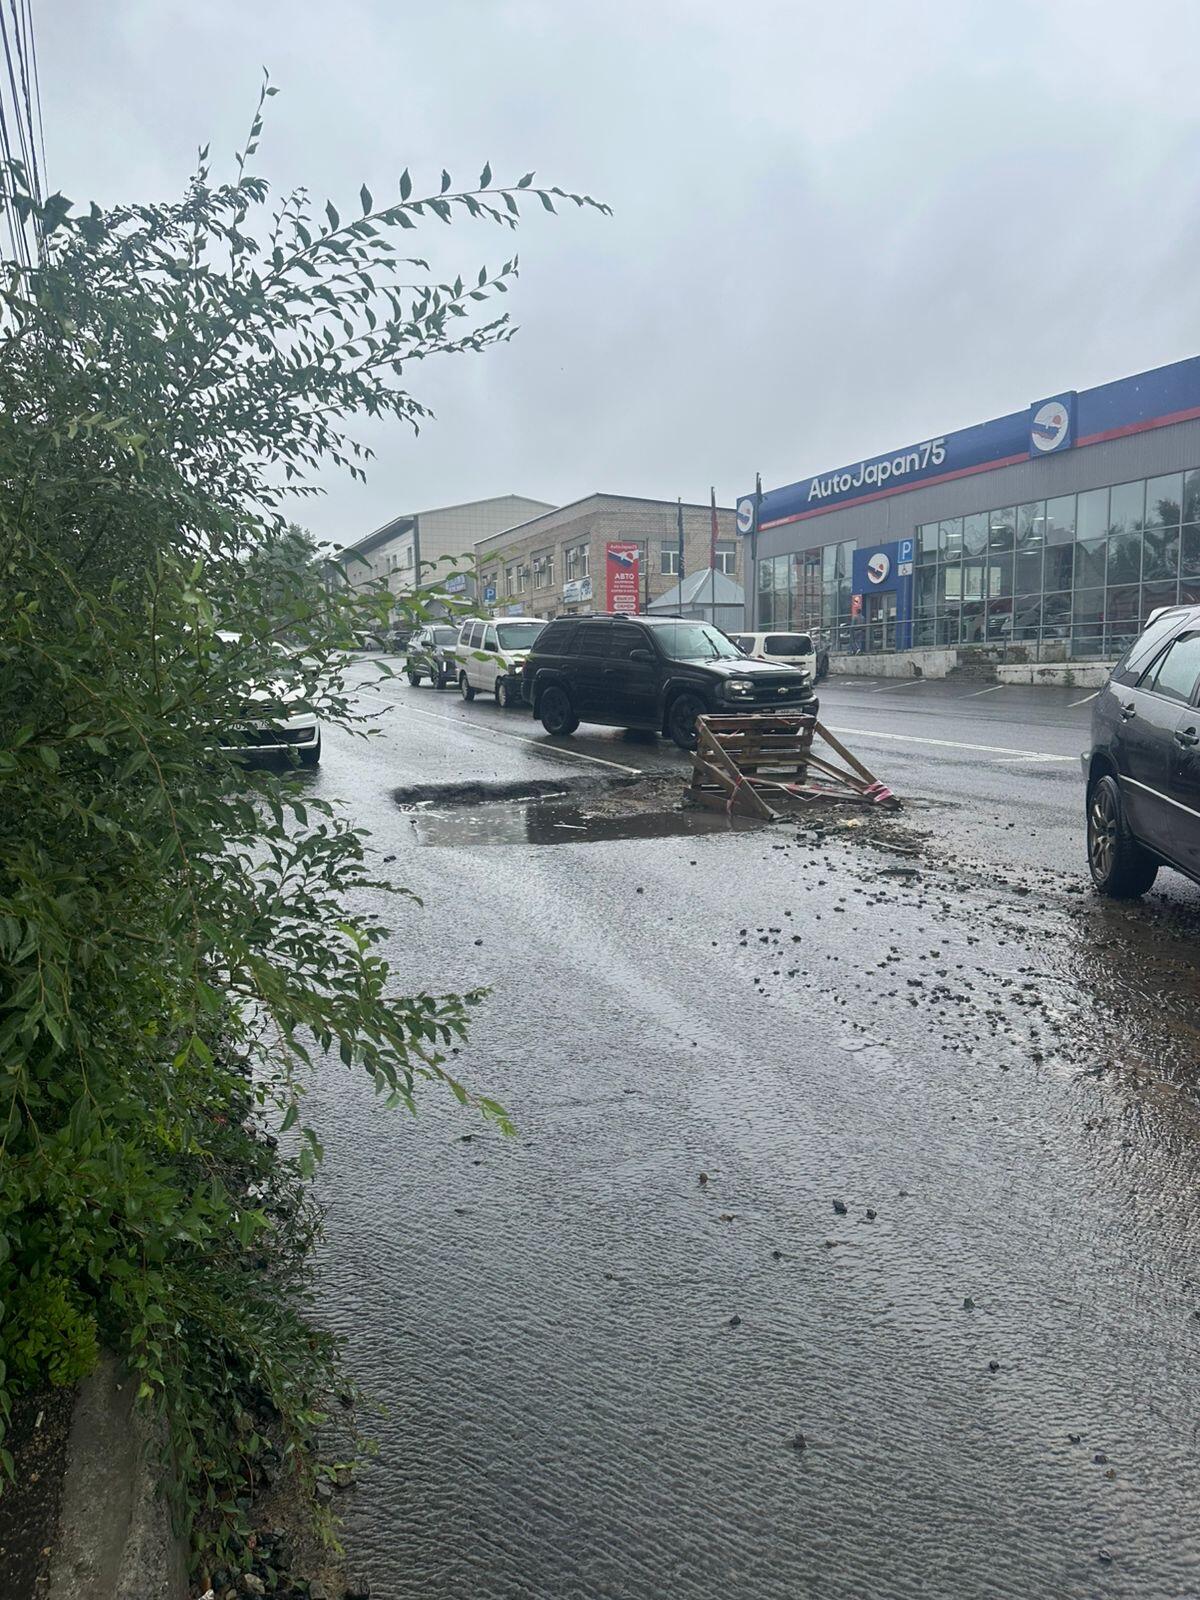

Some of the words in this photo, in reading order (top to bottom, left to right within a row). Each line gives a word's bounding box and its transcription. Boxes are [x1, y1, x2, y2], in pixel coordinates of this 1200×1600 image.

[807, 438, 946, 502] AutoJapan75
[902, 541, 912, 560] P
[486, 589, 495, 601] P
